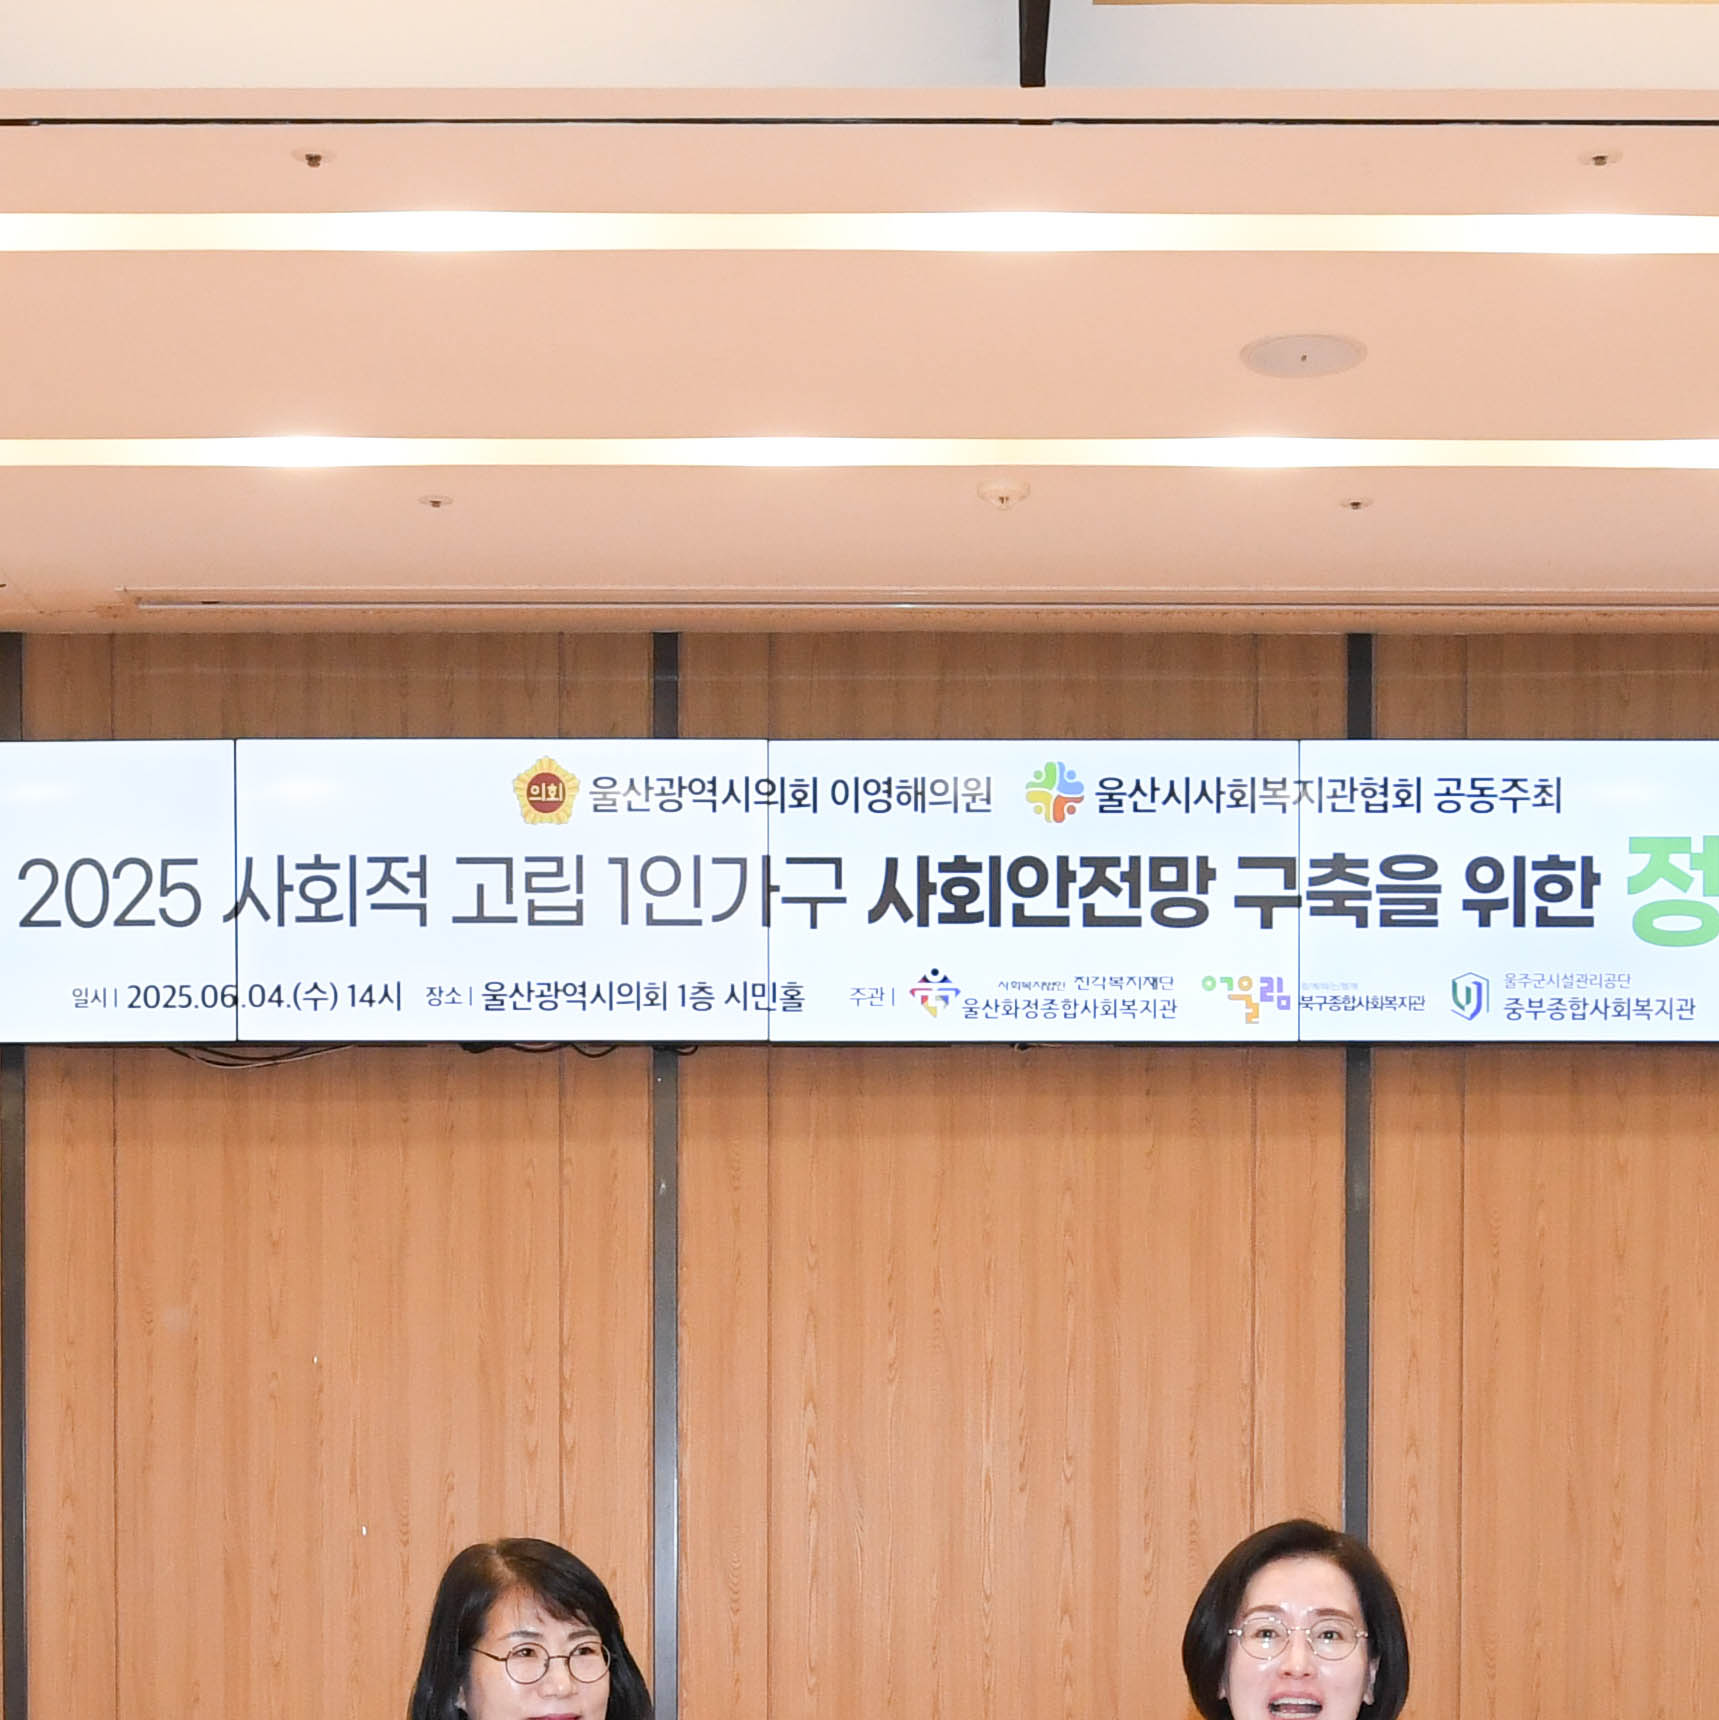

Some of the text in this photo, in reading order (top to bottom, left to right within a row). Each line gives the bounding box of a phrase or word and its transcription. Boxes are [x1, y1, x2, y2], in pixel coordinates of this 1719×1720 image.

[588, 776, 992, 816] 울산광역시의회 이영해의원
[1094, 776, 1562, 816] 울산시사회복지관협회 공동주최
[17, 857, 202, 929] 2025
[223, 853, 428, 929] 사회적
[451, 854, 584, 928] 고립
[607, 854, 848, 929] 1인가구
[866, 852, 1217, 930] 사회안전망
[1233, 852, 1443, 930] 구축을
[1460, 852, 1602, 930] 위한
[126, 982, 341, 1013] 2025.06.04.(수)
[346, 981, 402, 1012] 14시
[481, 981, 670, 1012] 울산광역시의회
[678, 981, 717, 1012] 1층
[724, 979, 806, 1014] 시민홀
[1503, 973, 1632, 990] 울주군시설관리공단
[962, 997, 1179, 1020] 울산화정종합사회복지관
[1502, 997, 1696, 1022] 중부종합사회복지관
